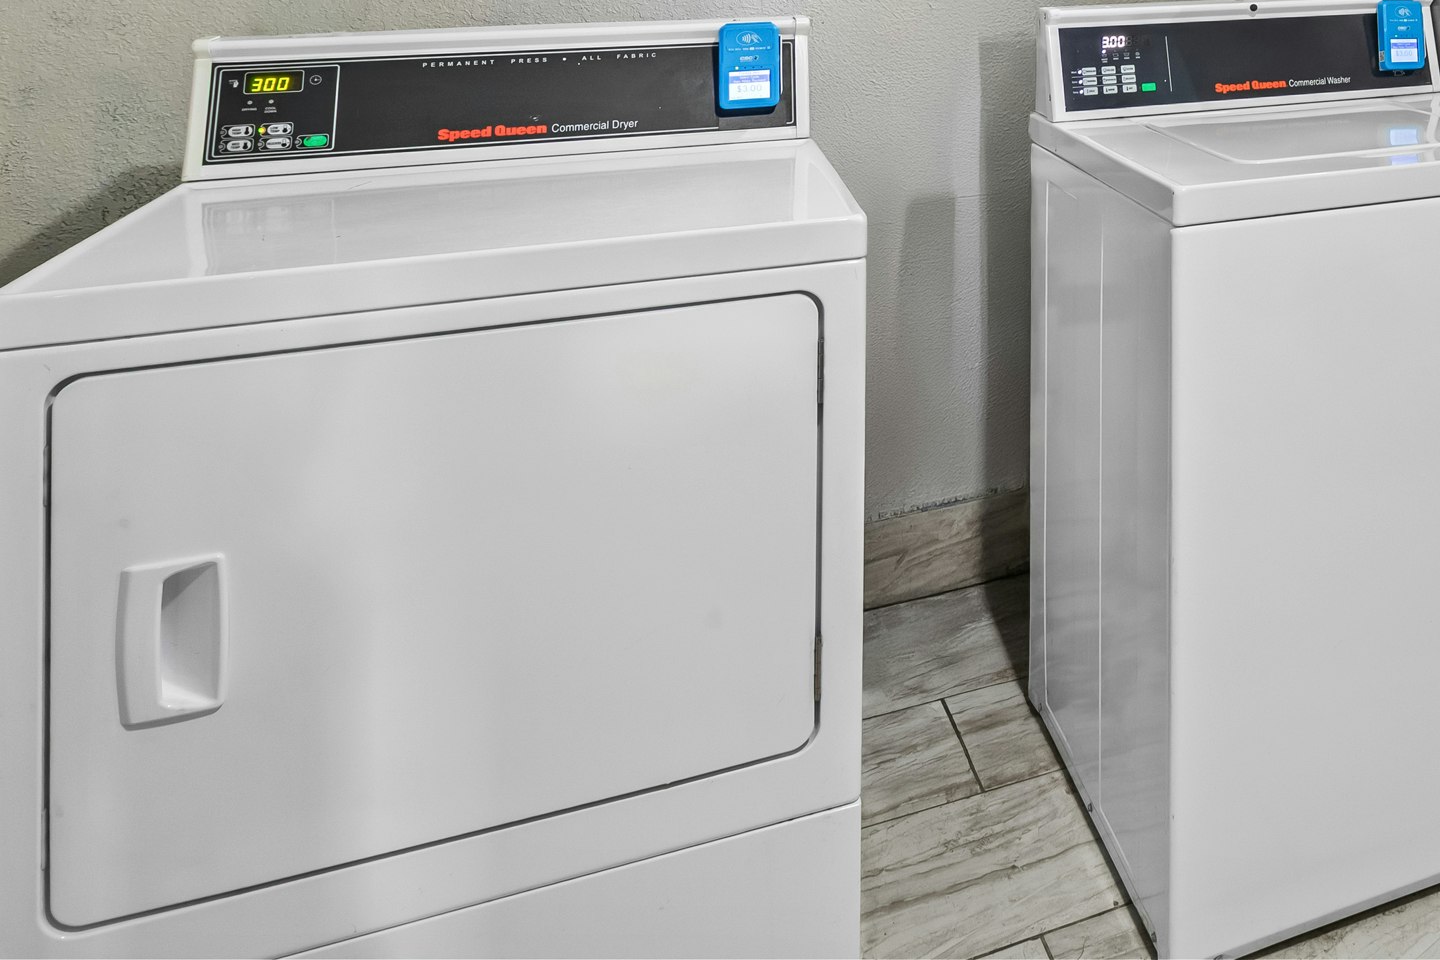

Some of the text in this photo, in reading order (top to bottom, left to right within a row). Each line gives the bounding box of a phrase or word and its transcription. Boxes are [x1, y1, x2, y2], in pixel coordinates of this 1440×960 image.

[422, 58, 495, 68] PERMANENT
[251, 77, 290, 92] 300
[1214, 76, 1351, 94] Speed Queen Commercial Washer
[437, 119, 639, 142] Speed Queen Commercial Dryer
